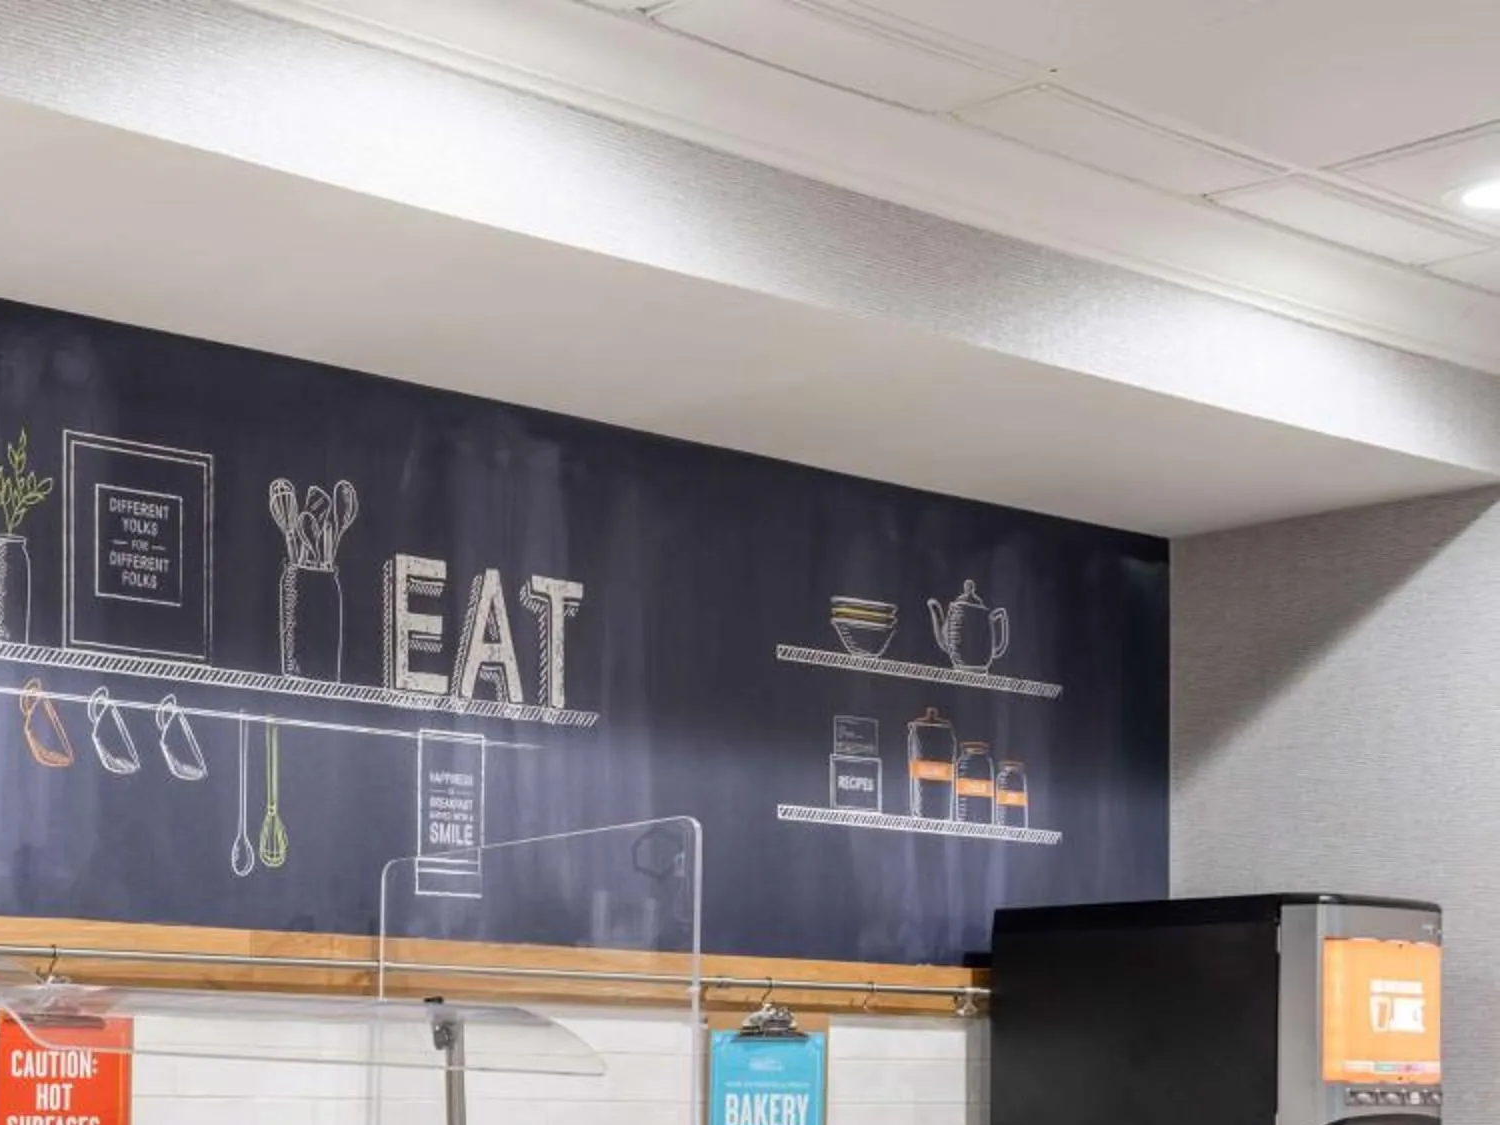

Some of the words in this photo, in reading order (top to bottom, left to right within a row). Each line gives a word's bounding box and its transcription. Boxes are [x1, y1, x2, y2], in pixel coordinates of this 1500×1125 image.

[109, 498, 170, 520] DIFFERENT
[122, 517, 158, 537] YOLKS
[109, 550, 170, 573] DIFFERENT
[122, 570, 157, 589] FOLKS
[383, 553, 584, 709] EAT
[429, 821, 474, 845] SMILE
[11, 1049, 98, 1078] CAUTION:
[36, 1083, 74, 1110] HOT
